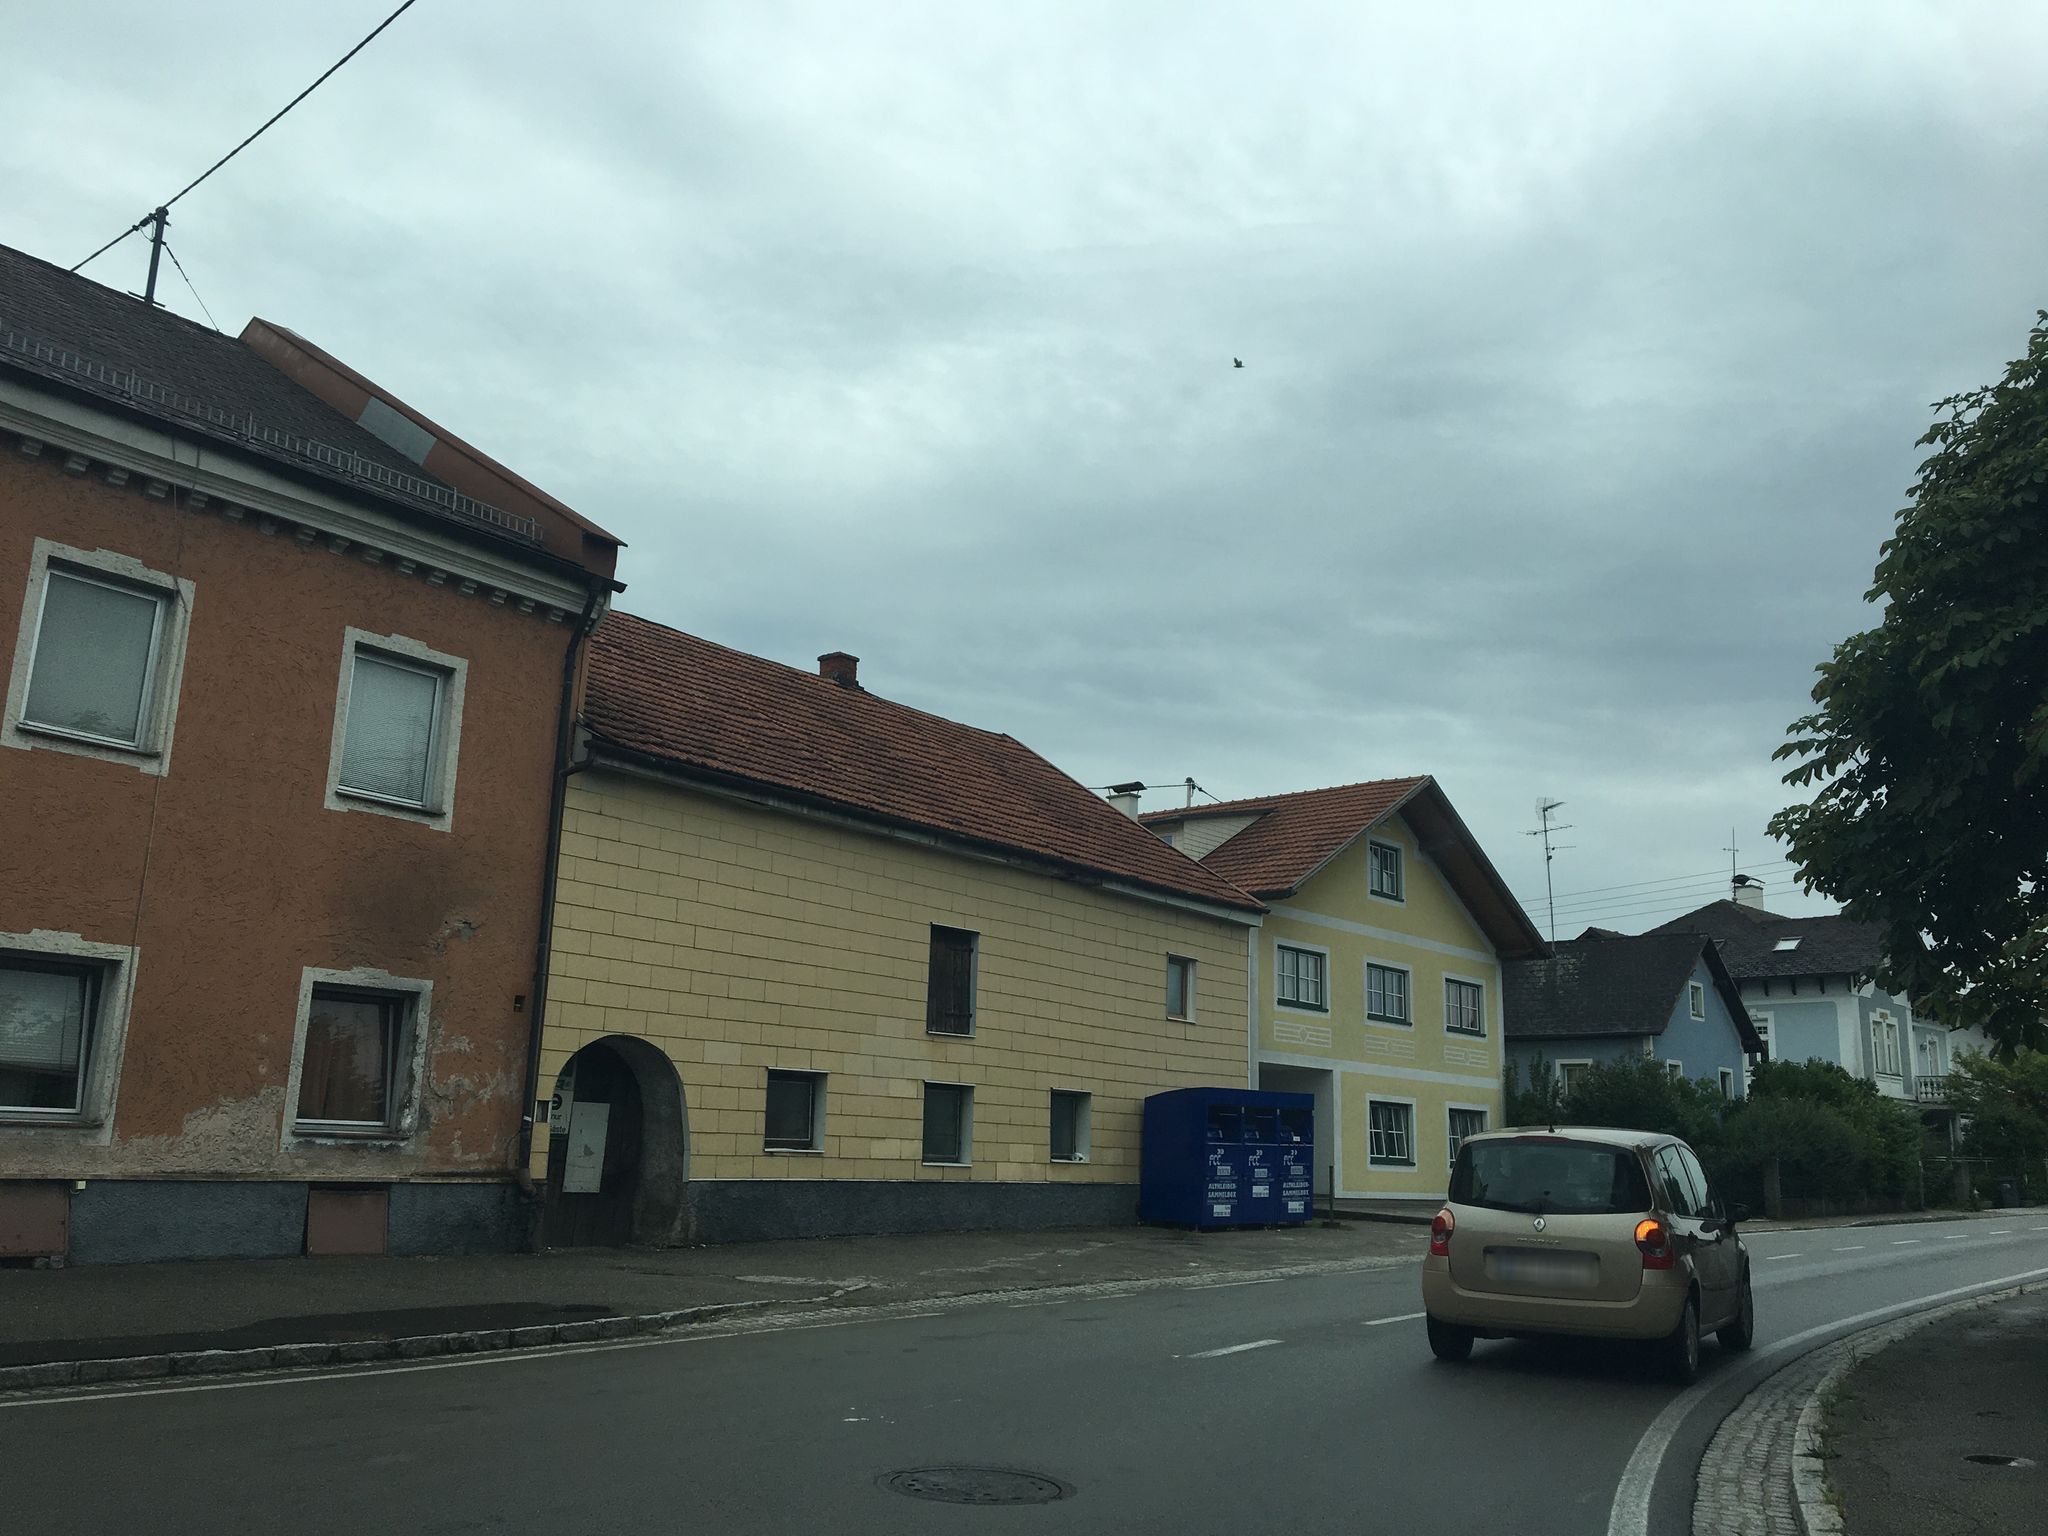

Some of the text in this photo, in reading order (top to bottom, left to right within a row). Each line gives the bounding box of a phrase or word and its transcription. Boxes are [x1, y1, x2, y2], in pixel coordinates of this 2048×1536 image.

[1209, 1154, 1221, 1166] FCC
[1248, 1155, 1260, 1166] FCC
[1283, 1155, 1294, 1166] FCC
